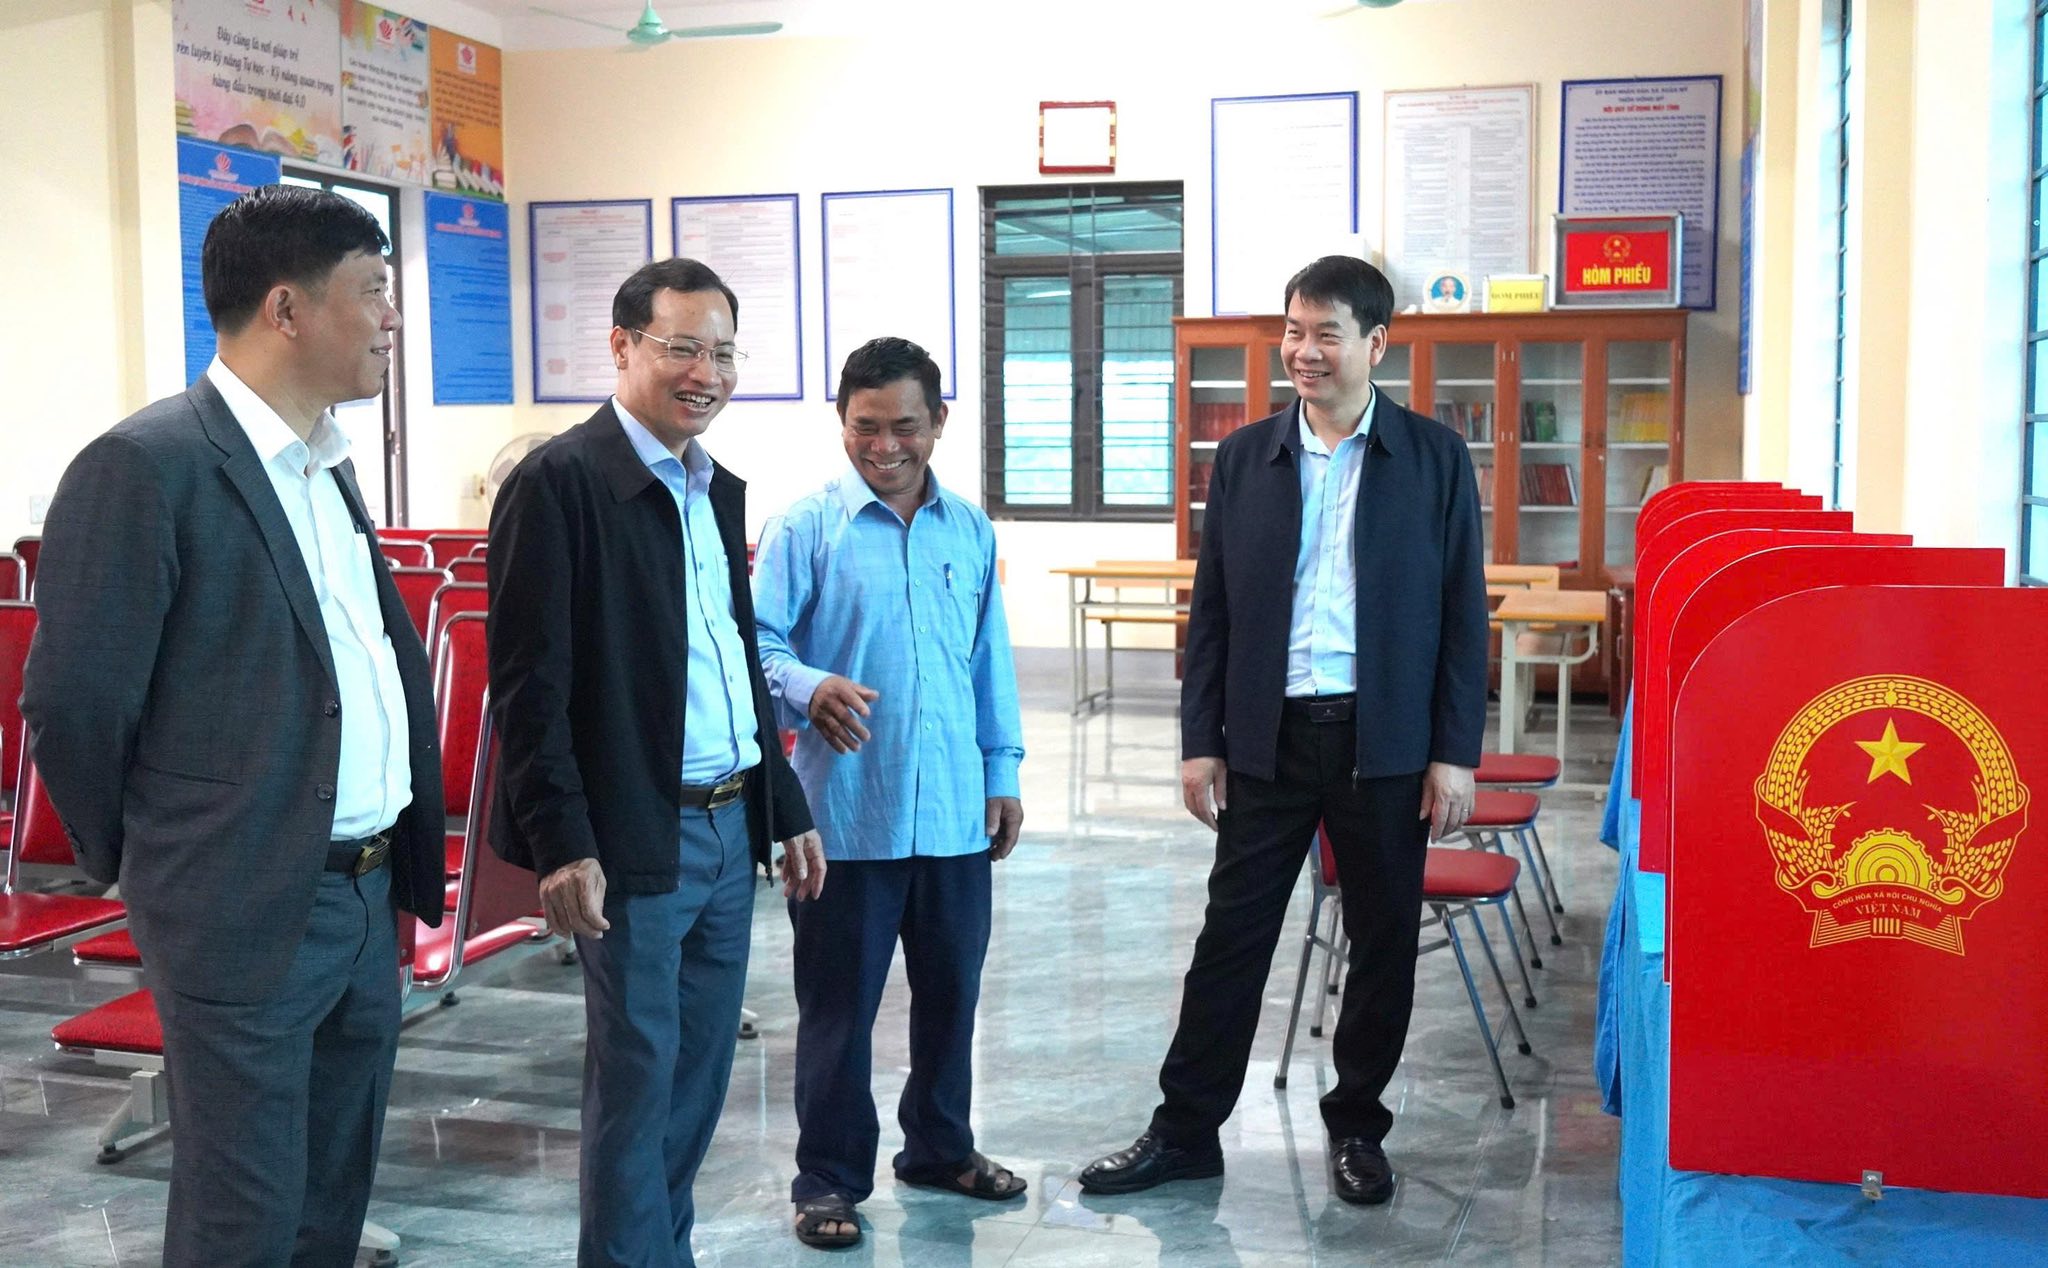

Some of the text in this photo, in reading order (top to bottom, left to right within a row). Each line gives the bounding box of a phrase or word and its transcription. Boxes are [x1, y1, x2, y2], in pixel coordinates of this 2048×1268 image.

[217, 25, 231, 45] Đây
[1582, 262, 1652, 285] HÒM PHIẾU
[1855, 892, 1872, 901] HÒA
[1855, 900, 1920, 918] VIỆT NAM
